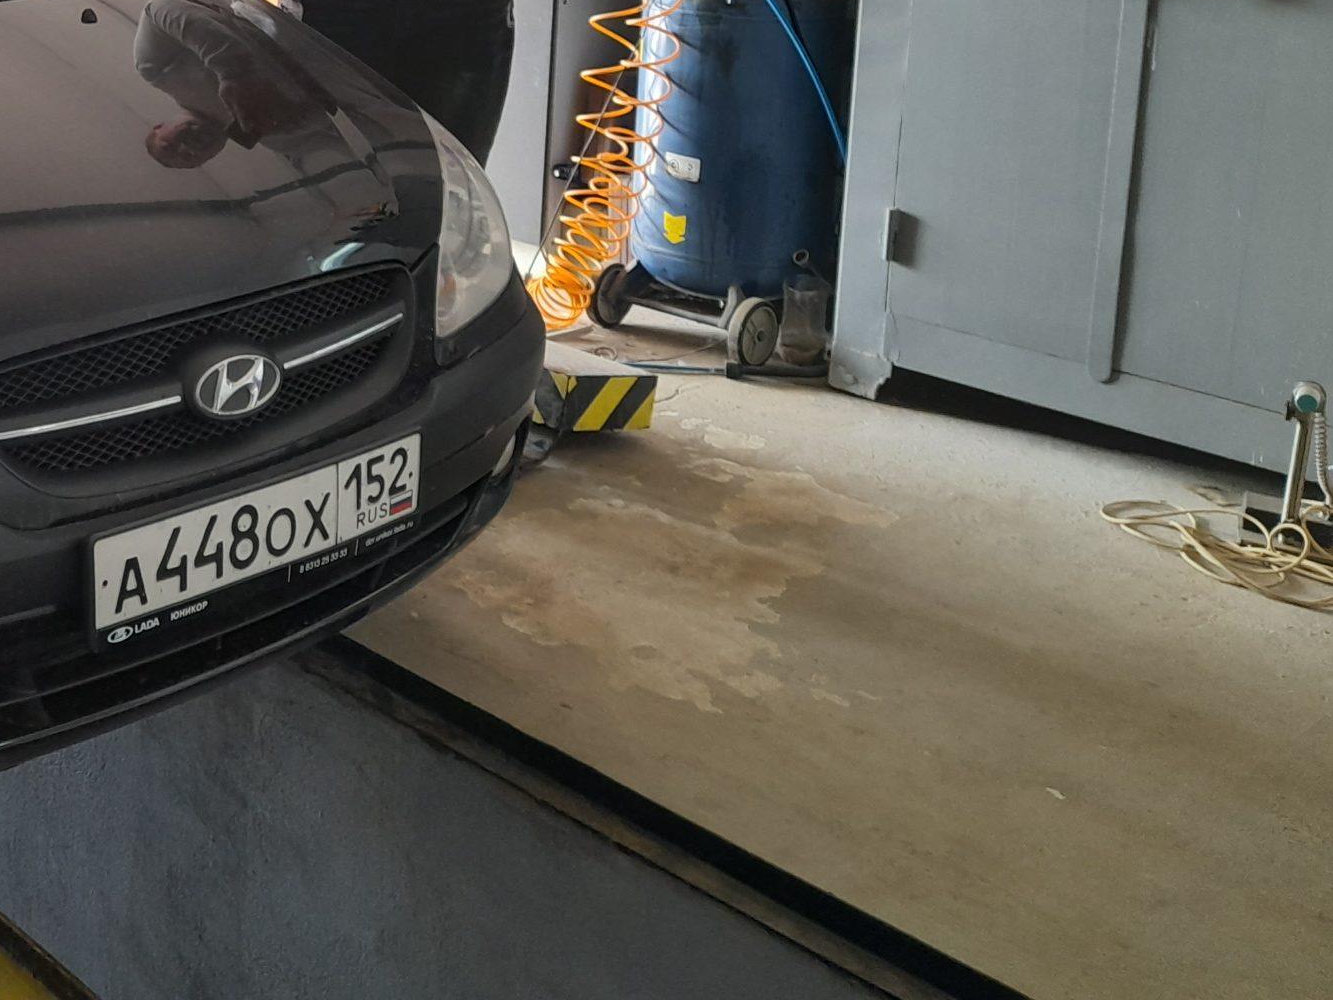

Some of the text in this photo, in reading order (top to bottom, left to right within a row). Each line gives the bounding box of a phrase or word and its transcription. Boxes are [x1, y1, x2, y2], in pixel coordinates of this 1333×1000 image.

[356, 503, 389, 529] RUS
[115, 447, 409, 614] А448ОХ 152
[170, 600, 209, 622] ЮНИКОР
[134, 617, 161, 634] LADA
